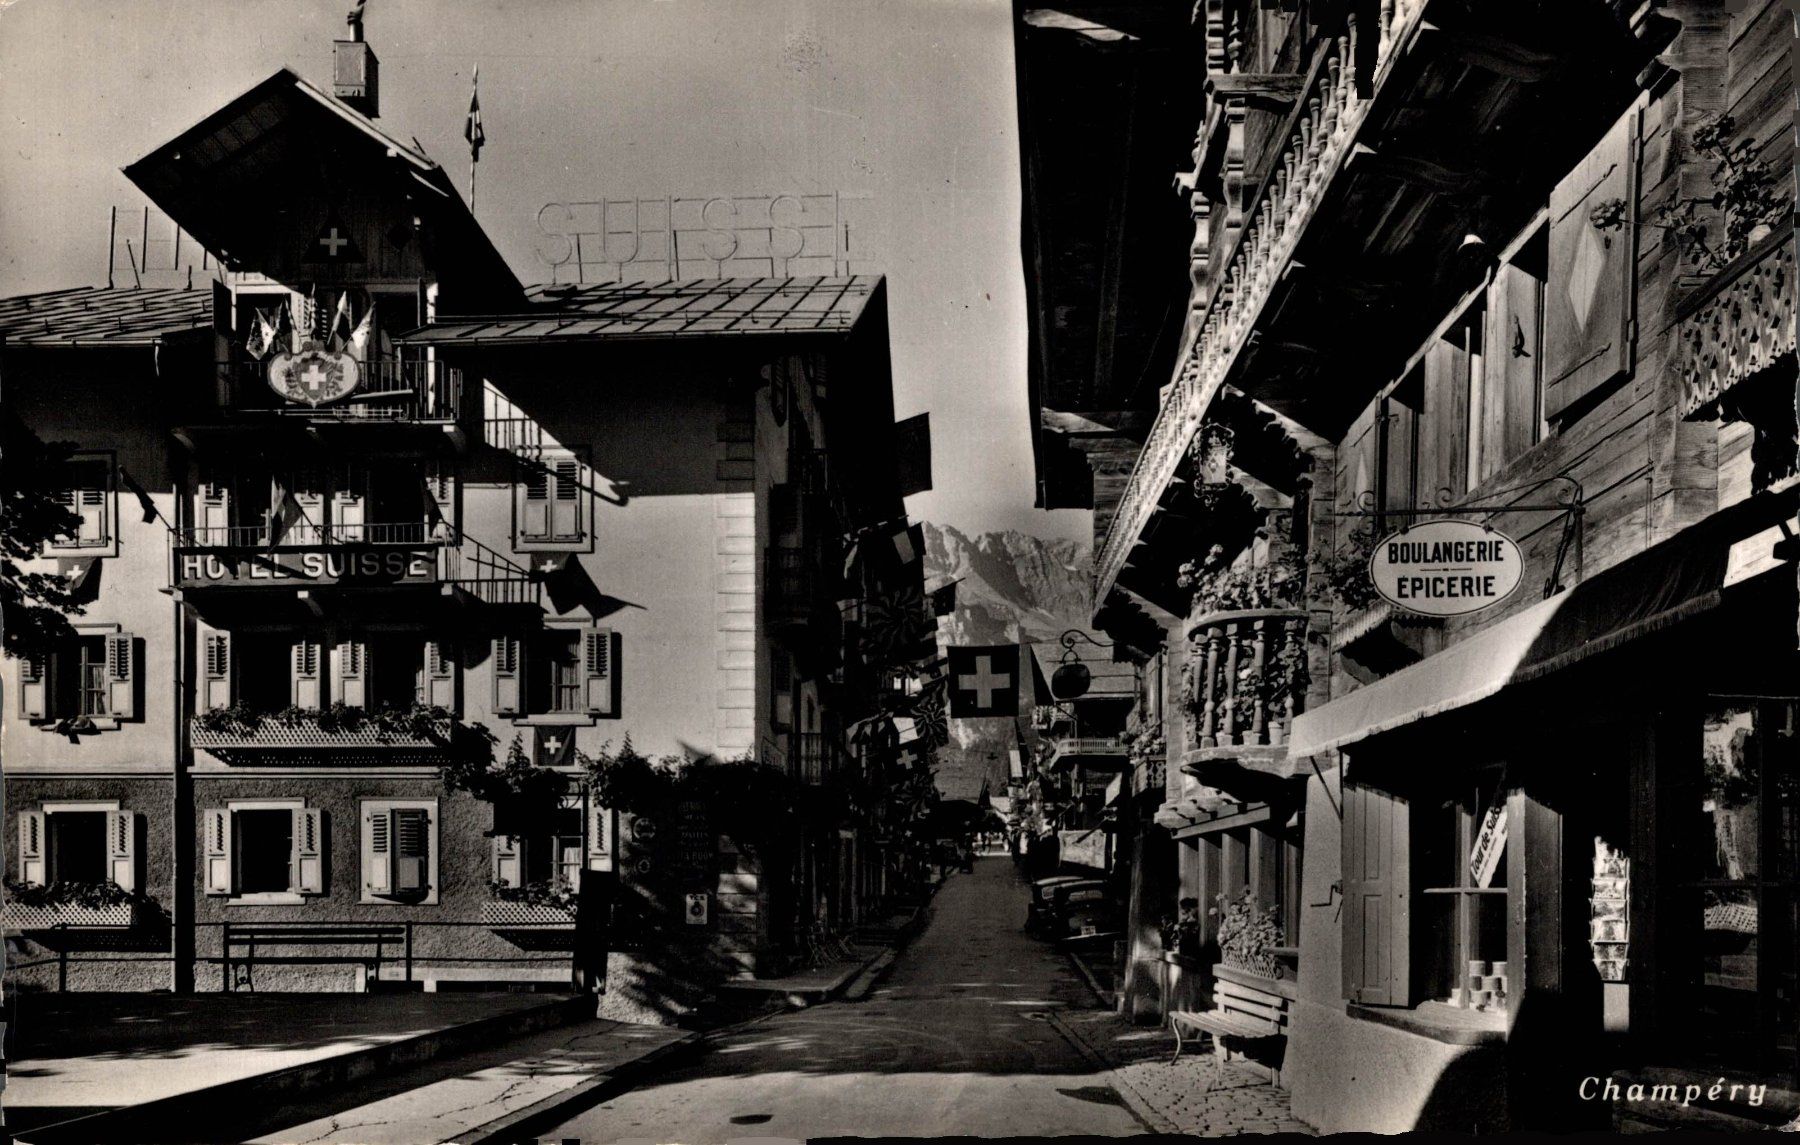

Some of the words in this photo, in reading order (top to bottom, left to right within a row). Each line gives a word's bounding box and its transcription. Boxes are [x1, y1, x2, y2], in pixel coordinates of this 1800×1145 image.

[183, 554, 289, 580] HOTEL
[303, 551, 428, 578] SUISSE
[1388, 541, 1505, 564] BOULANGERIE
[1471, 846, 1485, 875] Tour
[1481, 832, 1491, 852] de
